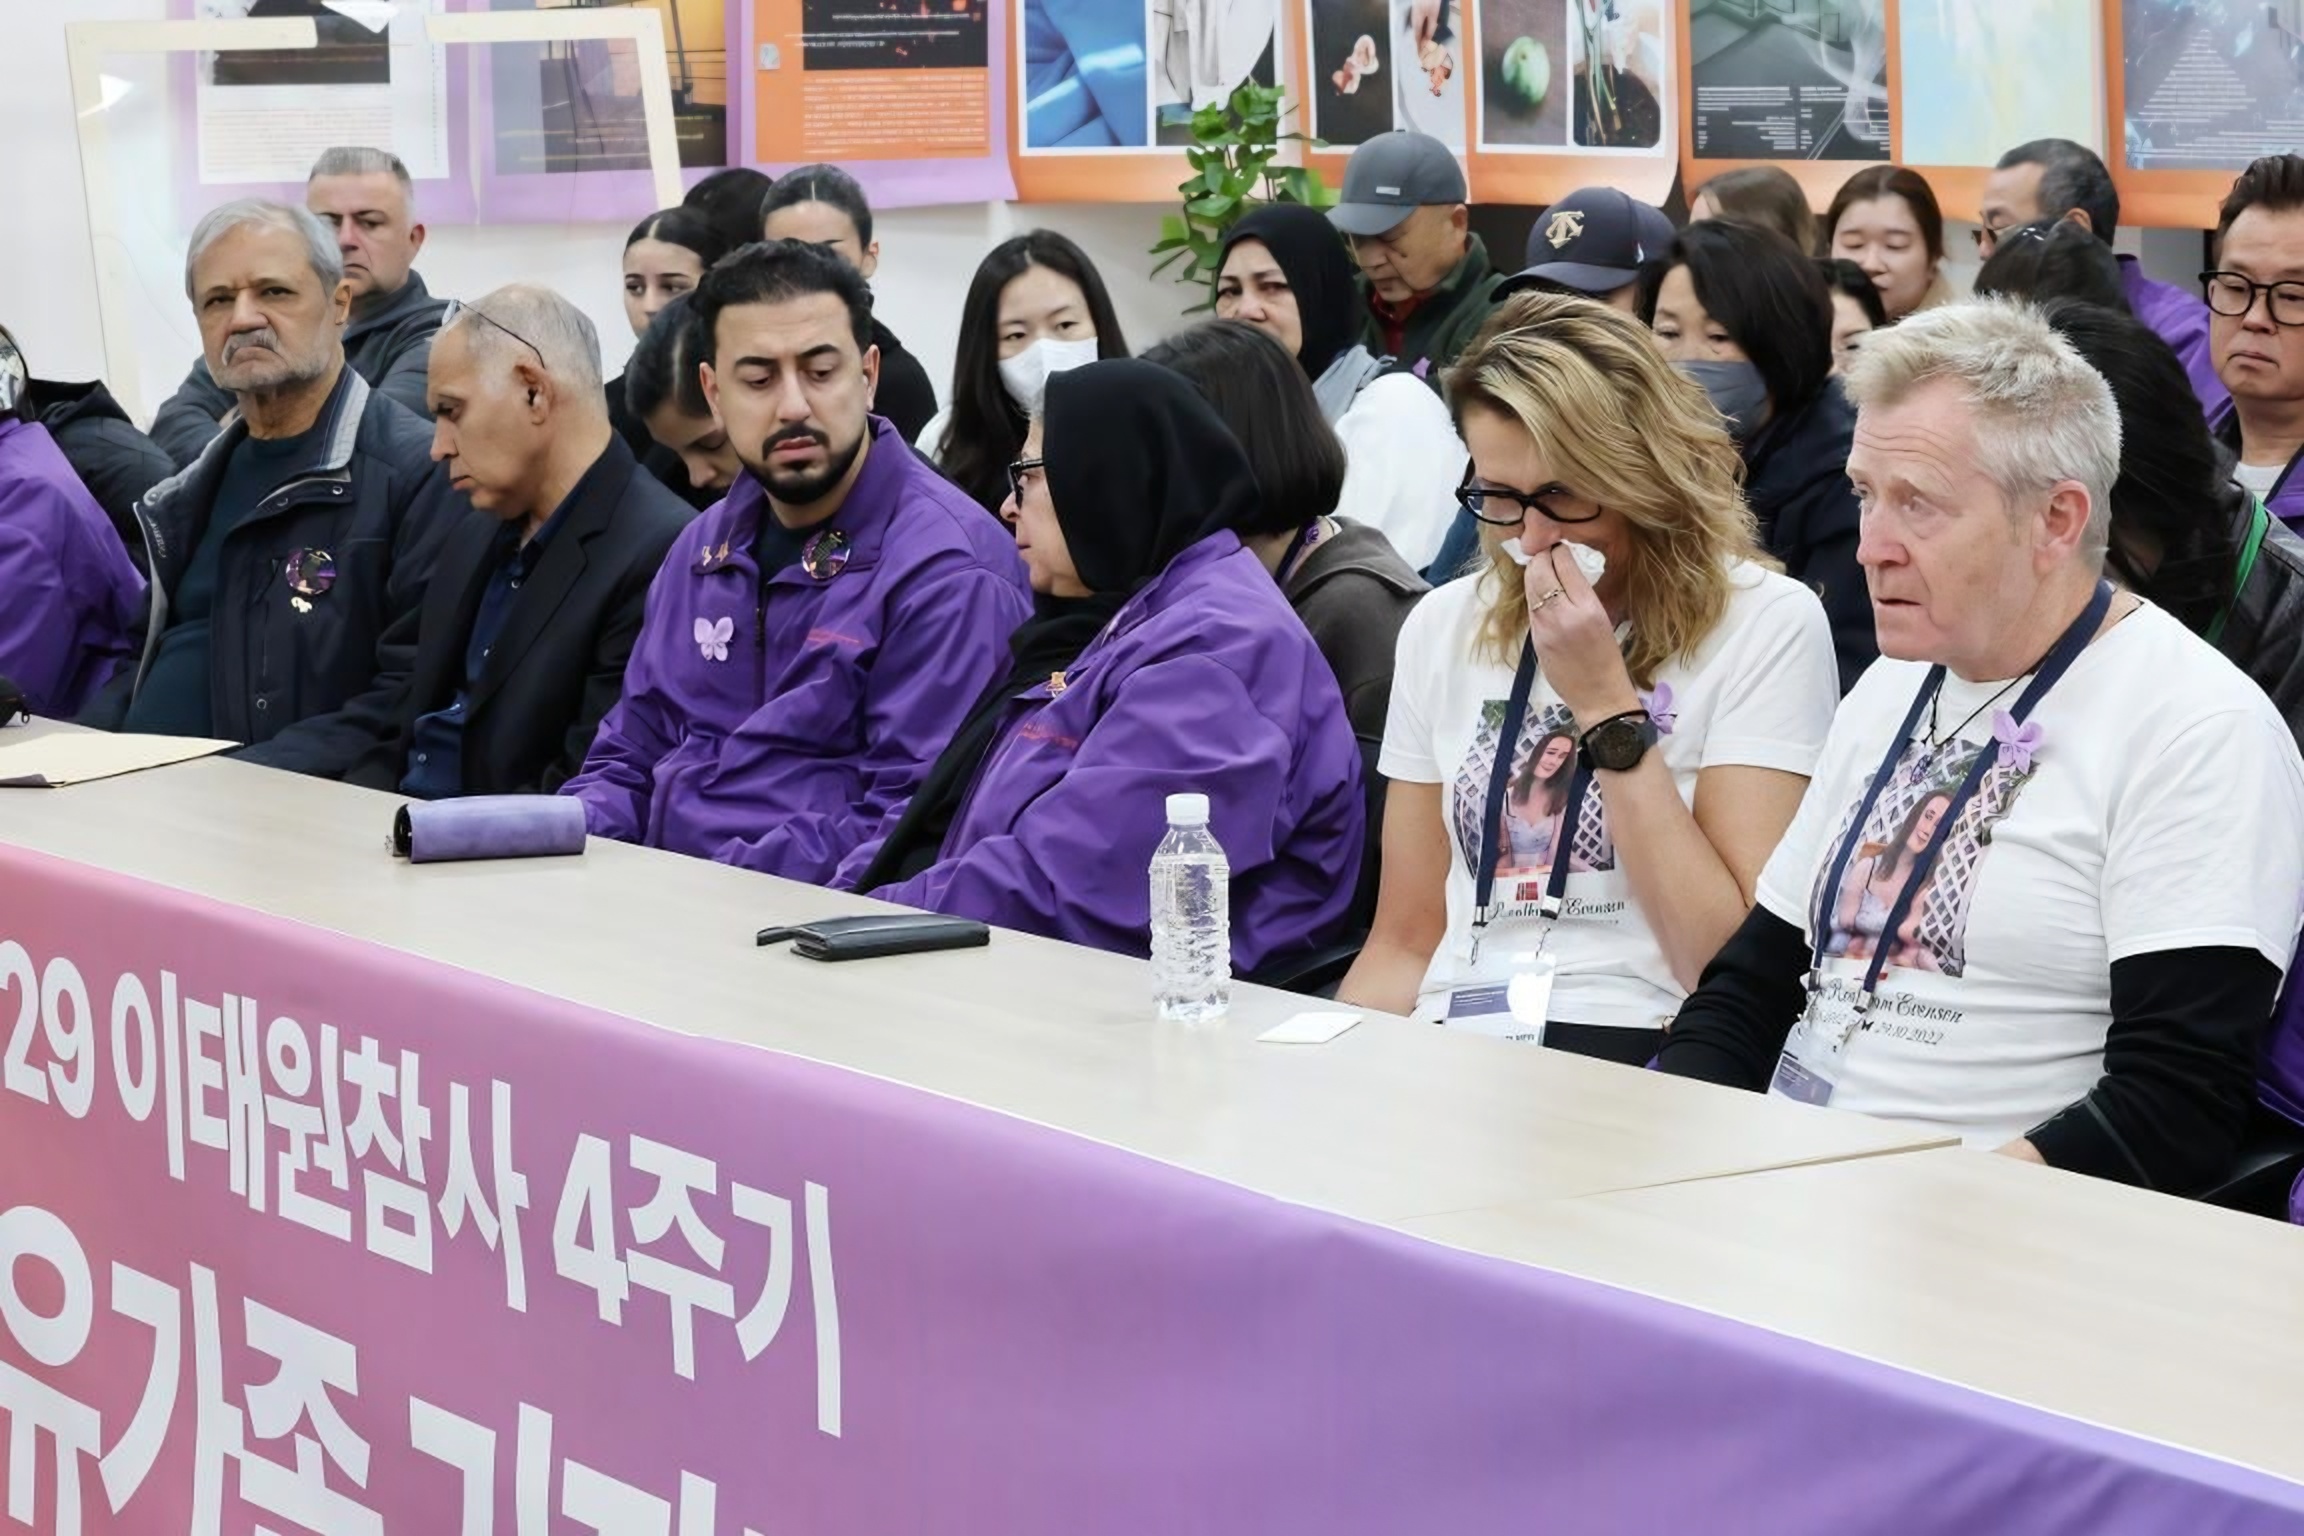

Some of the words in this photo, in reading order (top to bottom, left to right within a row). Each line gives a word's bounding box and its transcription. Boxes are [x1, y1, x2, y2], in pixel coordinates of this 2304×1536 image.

[0, 1205, 385, 1536] 유가족
[110, 970, 530, 1313] 이태원참사
[552, 1132, 842, 1438] 4주기
